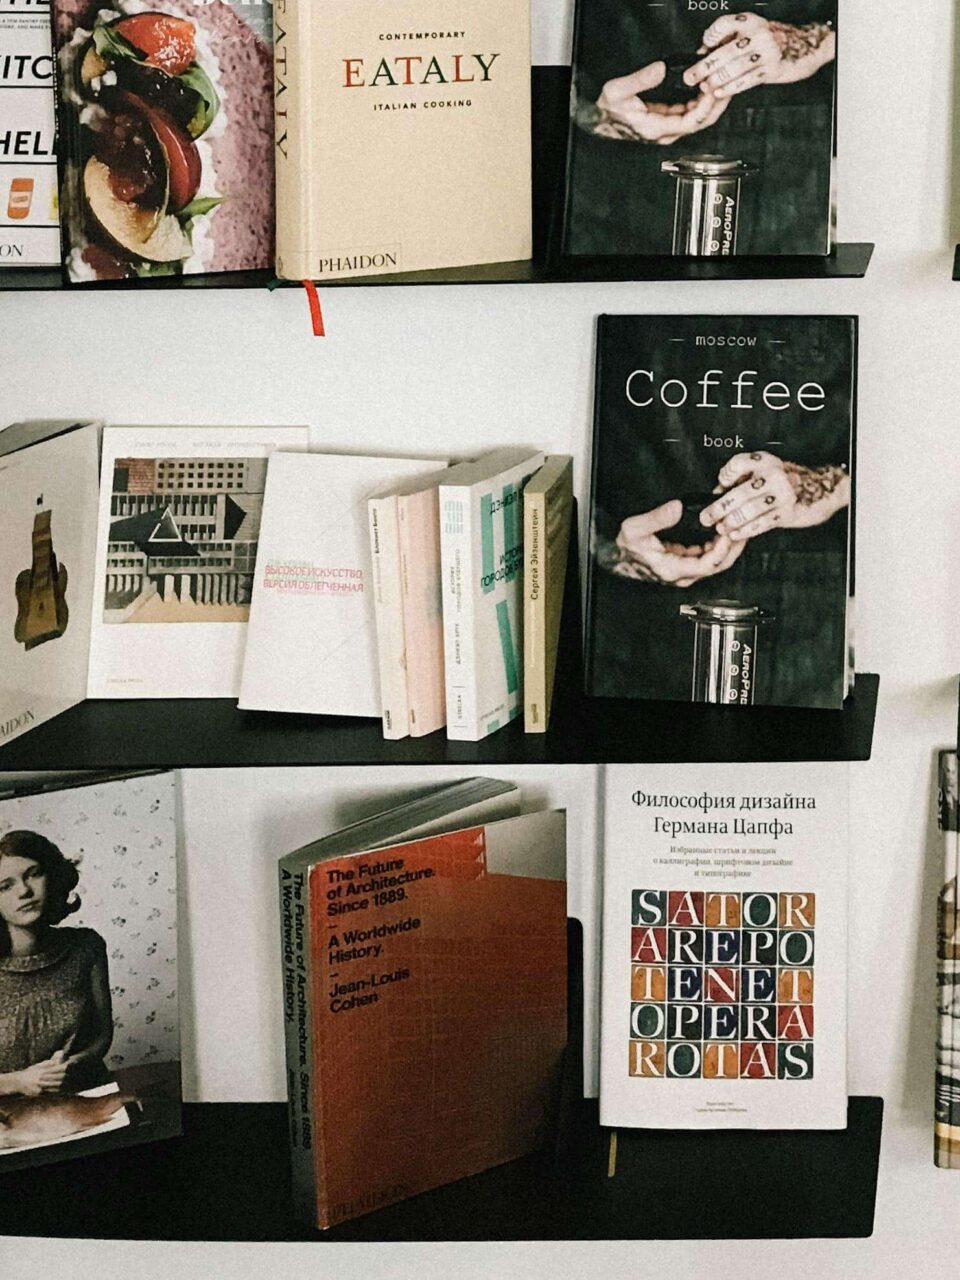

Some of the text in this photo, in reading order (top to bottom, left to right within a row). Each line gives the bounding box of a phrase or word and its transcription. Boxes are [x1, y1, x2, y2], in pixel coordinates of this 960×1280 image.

[379, 31, 466, 41] CONTEMPORARY
[341, 53, 501, 88] EATALY
[373, 99, 473, 111] ITALIAN COOKING
[318, 251, 398, 273] PHAIDON
[695, 334, 757, 347] moscow
[625, 369, 827, 411] Coffee
[703, 434, 744, 449] book
[530, 508, 540, 600] Сергей Эйзенштейн
[631, 790, 817, 814] Философия дизайна
[653, 816, 794, 840] Германа Цапфа
[294, 872, 304, 899] The
[326, 868, 436, 901] of Architecture.
[327, 858, 404, 884] The Future
[281, 870, 295, 965] A Worldwide
[327, 887, 409, 917] Since 1889.
[638, 890, 813, 928] SATOR
[294, 904, 305, 951] Future
[328, 917, 421, 949] A Worldwide
[329, 943, 385, 965] History.
[633, 929, 814, 965] AREPO
[296, 955, 306, 972] of
[329, 967, 411, 999] Jean-Louis
[634, 967, 813, 1002] TENET
[329, 992, 379, 1014] Cohen
[632, 1004, 813, 1040] OPERA
[634, 1042, 808, 1080] ROTAS
